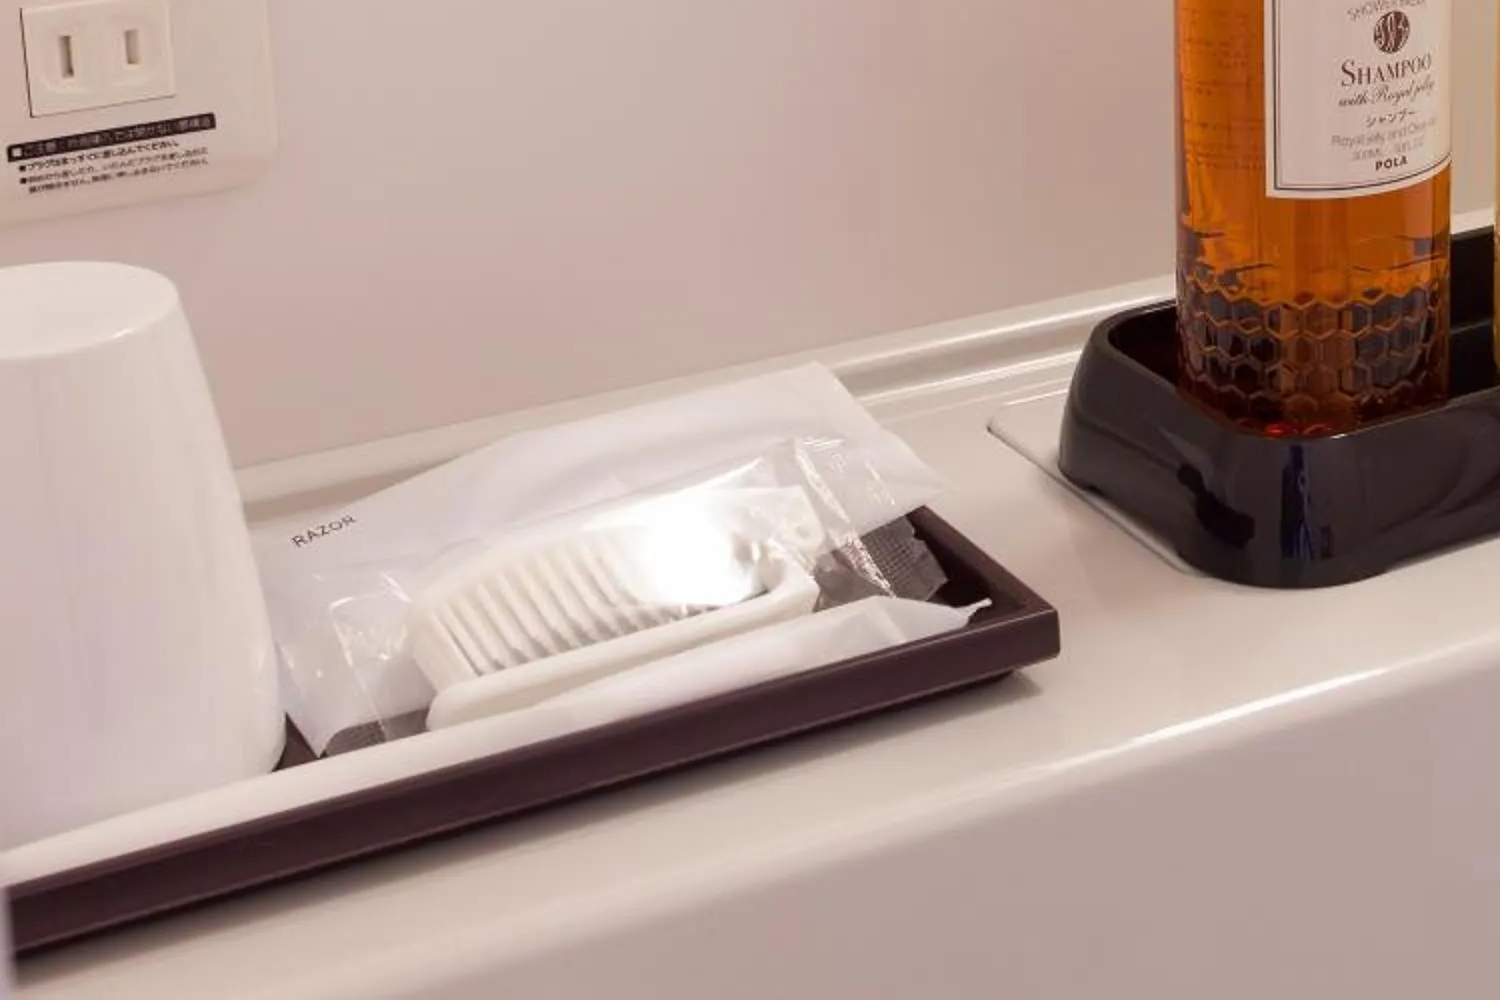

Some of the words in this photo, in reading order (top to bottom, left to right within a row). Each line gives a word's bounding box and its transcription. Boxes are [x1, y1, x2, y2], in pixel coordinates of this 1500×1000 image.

[1340, 53, 1432, 88] SHAMPOO
[1338, 89, 1369, 108] with
[1364, 107, 1417, 129] シャンプー
[1375, 155, 1408, 171] POLA
[291, 514, 357, 548] RAZOR
